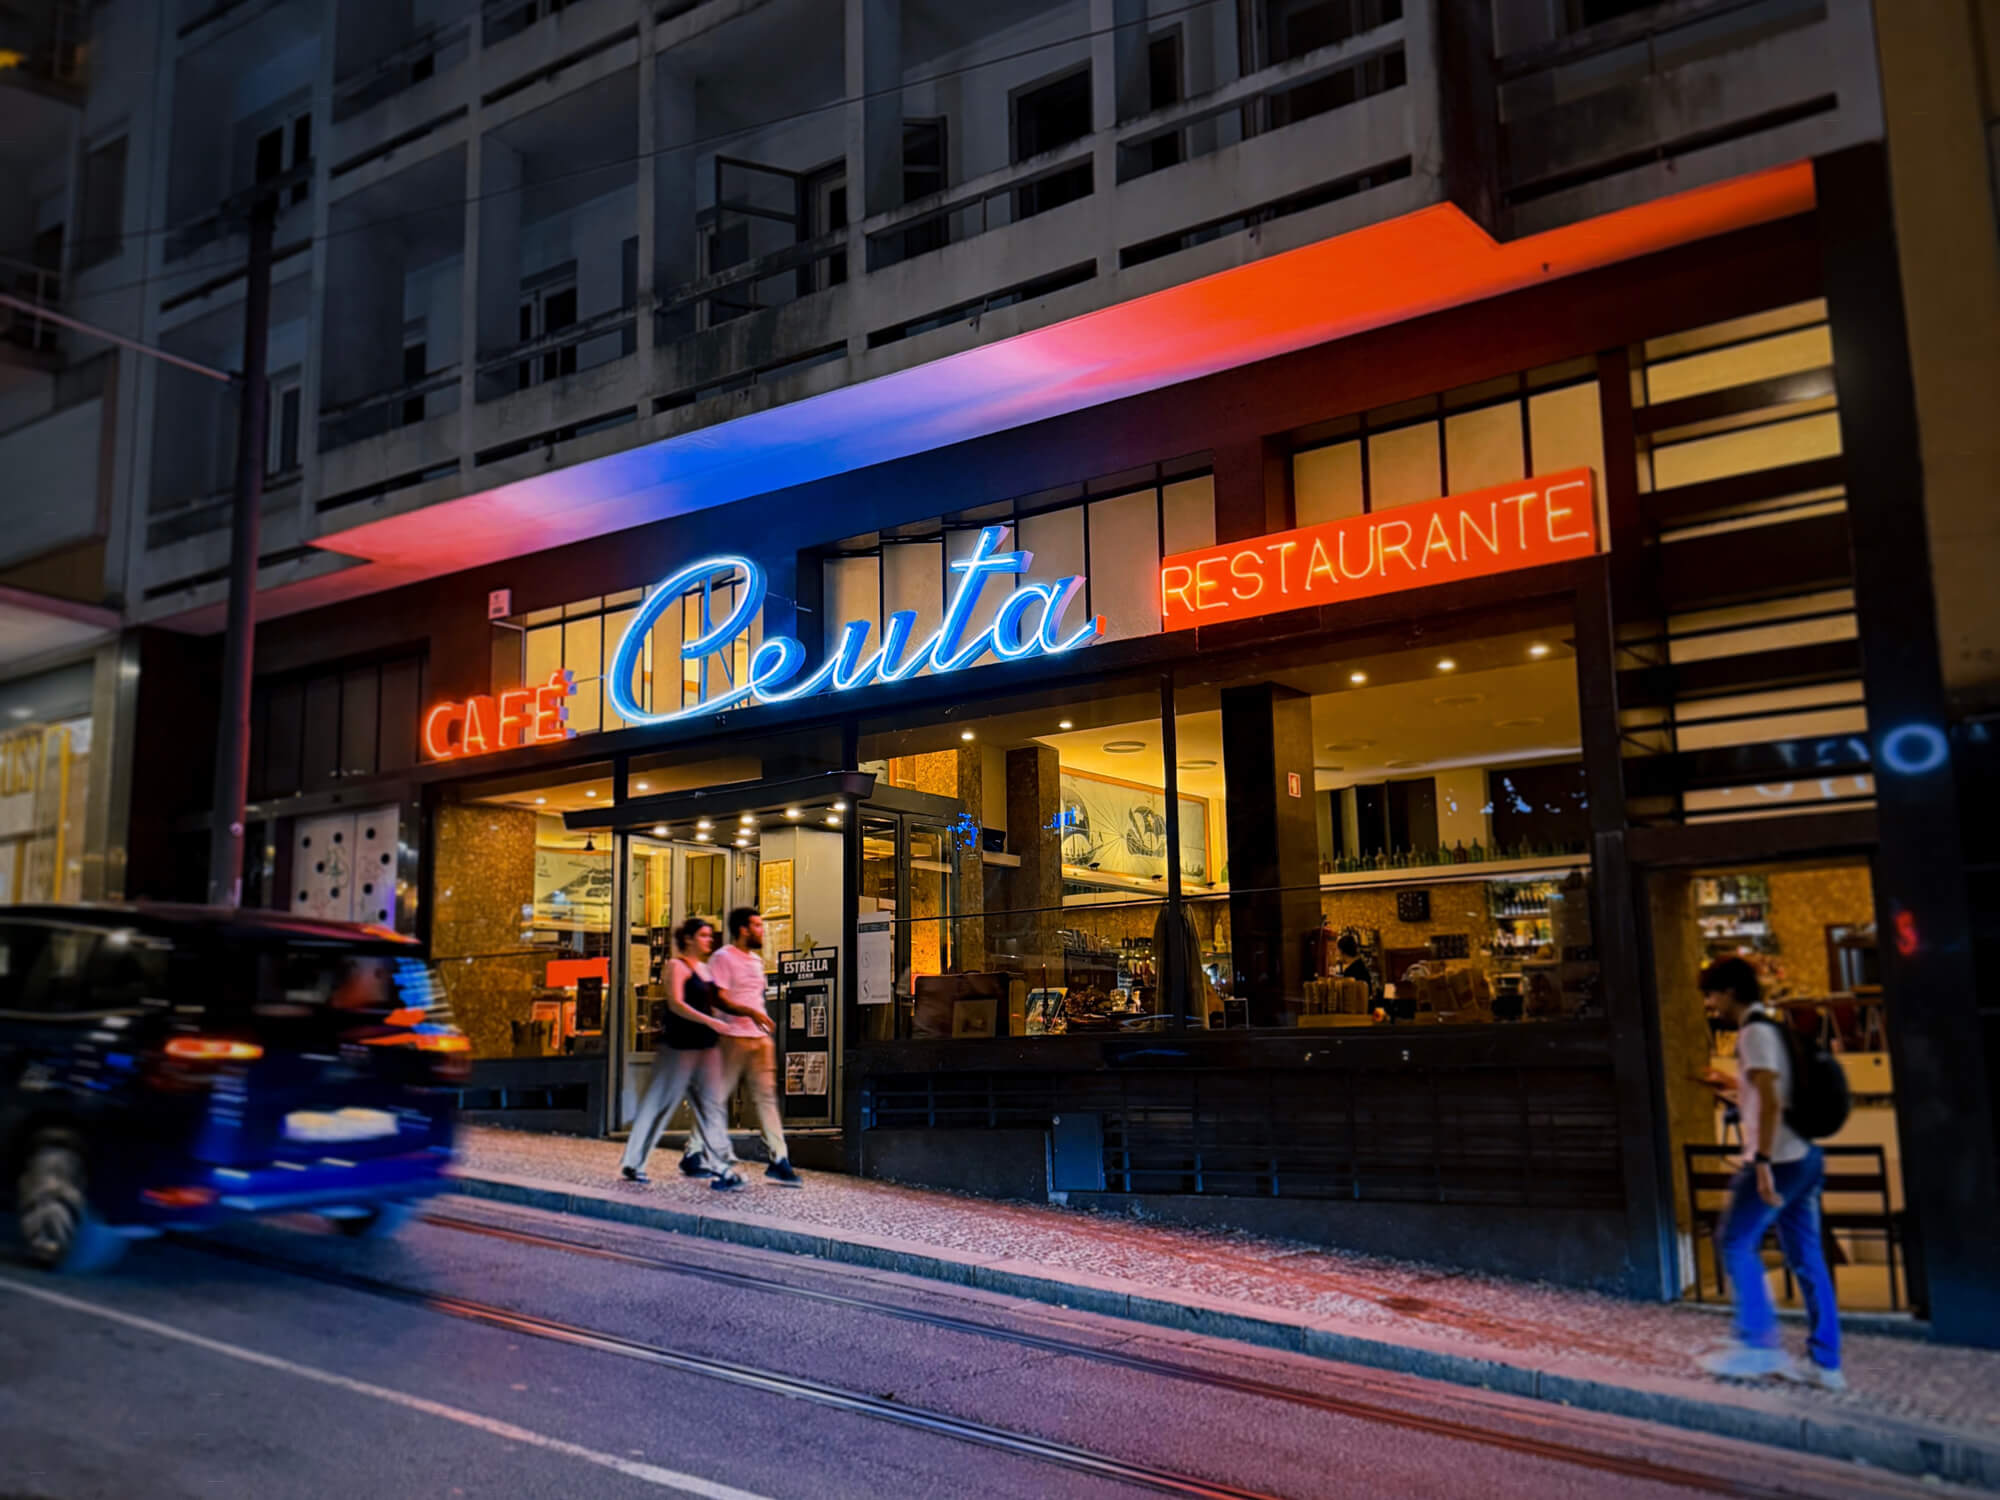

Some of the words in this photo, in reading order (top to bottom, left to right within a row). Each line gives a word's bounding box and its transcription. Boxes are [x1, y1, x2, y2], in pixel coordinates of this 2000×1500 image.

[426, 669, 572, 759] CAFÉ
[1162, 481, 1590, 616] RESTAURANTE
[784, 959, 828, 974] ESTRELLA
